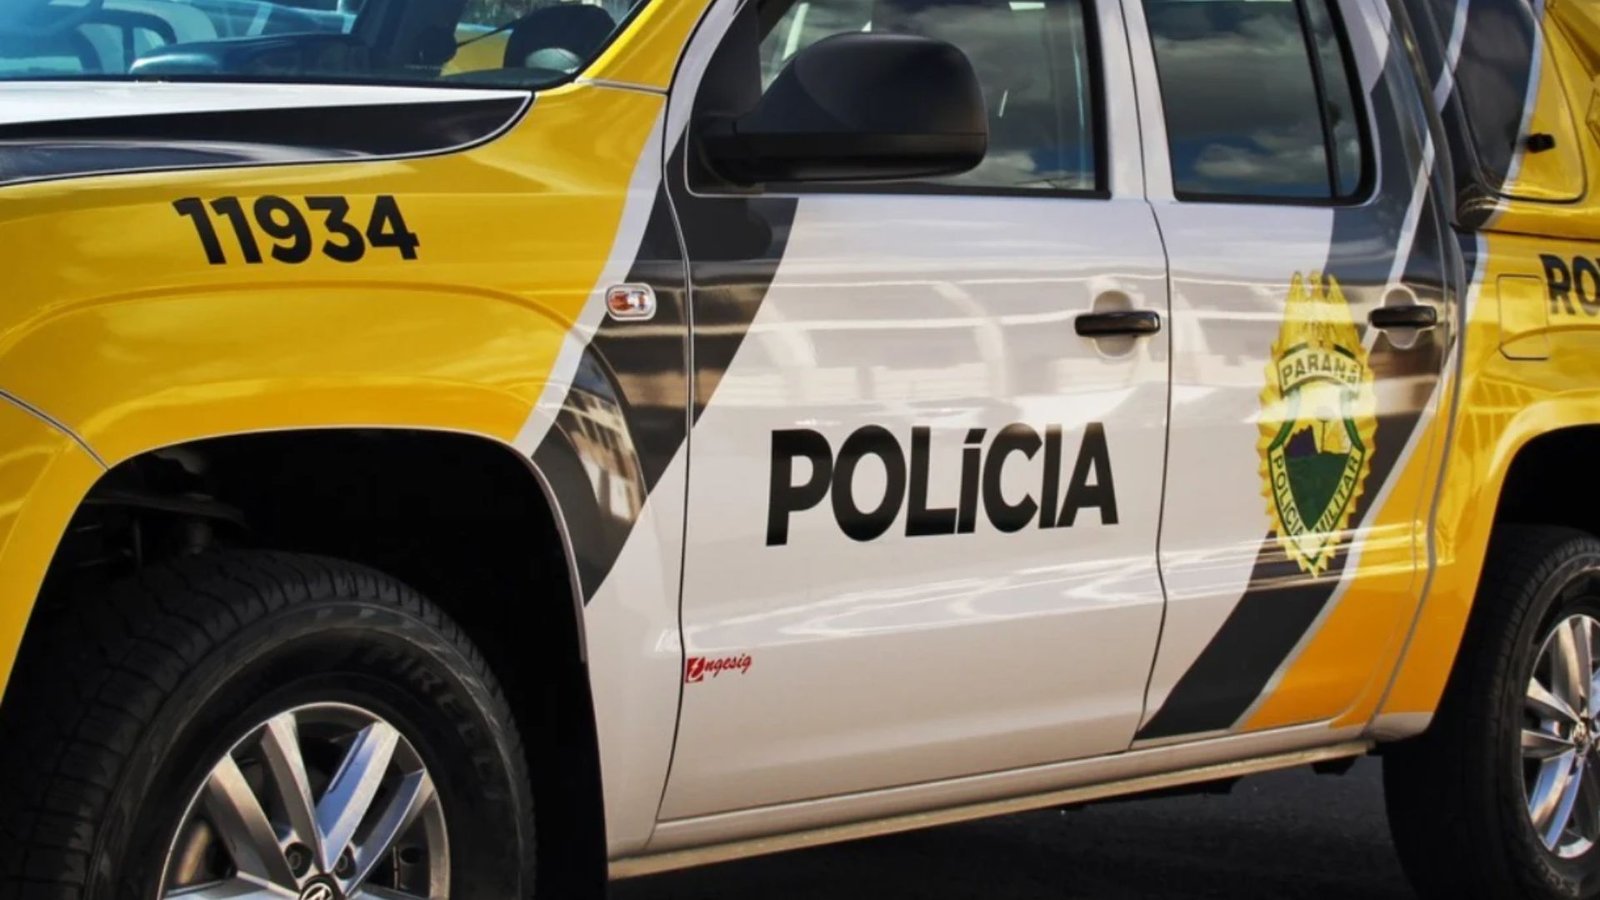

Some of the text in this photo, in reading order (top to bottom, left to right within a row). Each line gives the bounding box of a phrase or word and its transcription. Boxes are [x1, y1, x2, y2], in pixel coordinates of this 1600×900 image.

[173, 195, 420, 266] 11934
[1538, 253, 1600, 317] RO
[766, 422, 1119, 546] POLÍCIA
